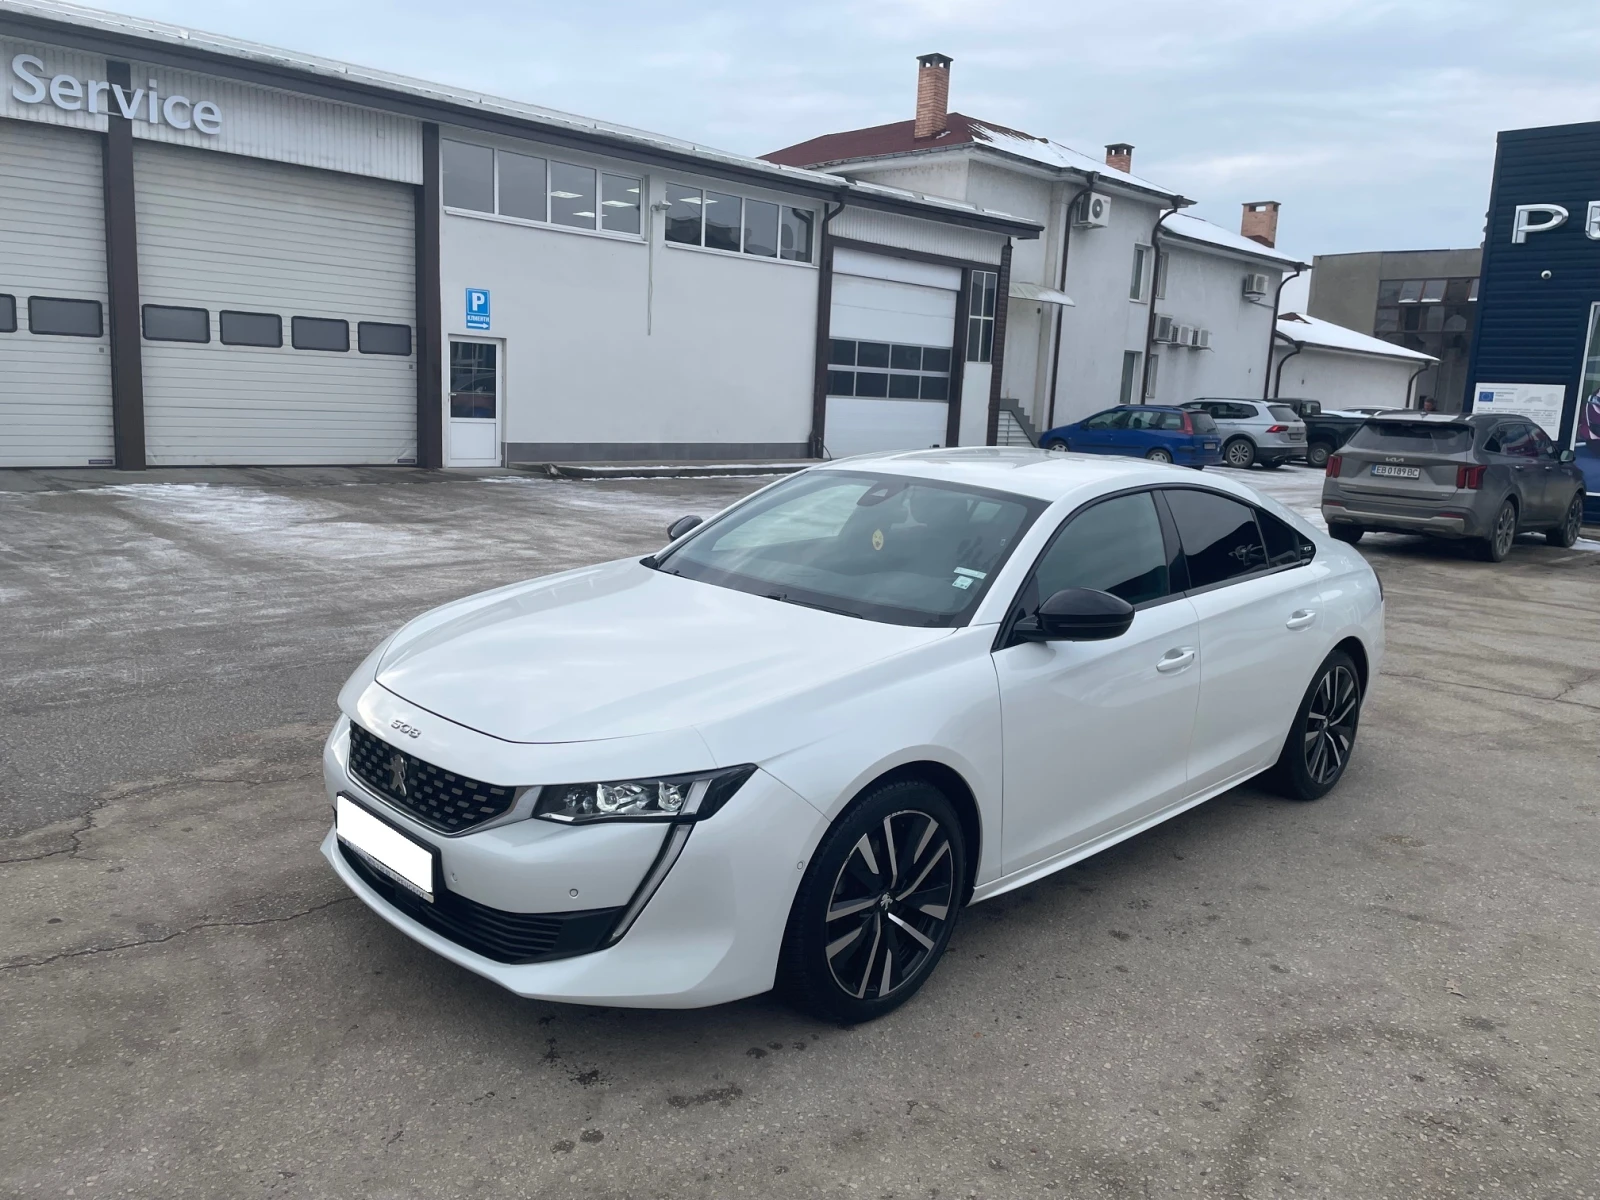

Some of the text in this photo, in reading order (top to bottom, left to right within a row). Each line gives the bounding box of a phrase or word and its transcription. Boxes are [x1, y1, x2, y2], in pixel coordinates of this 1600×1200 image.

[11, 53, 223, 135] Service
[472, 293, 485, 311] P
[390, 719, 421, 738] 508
